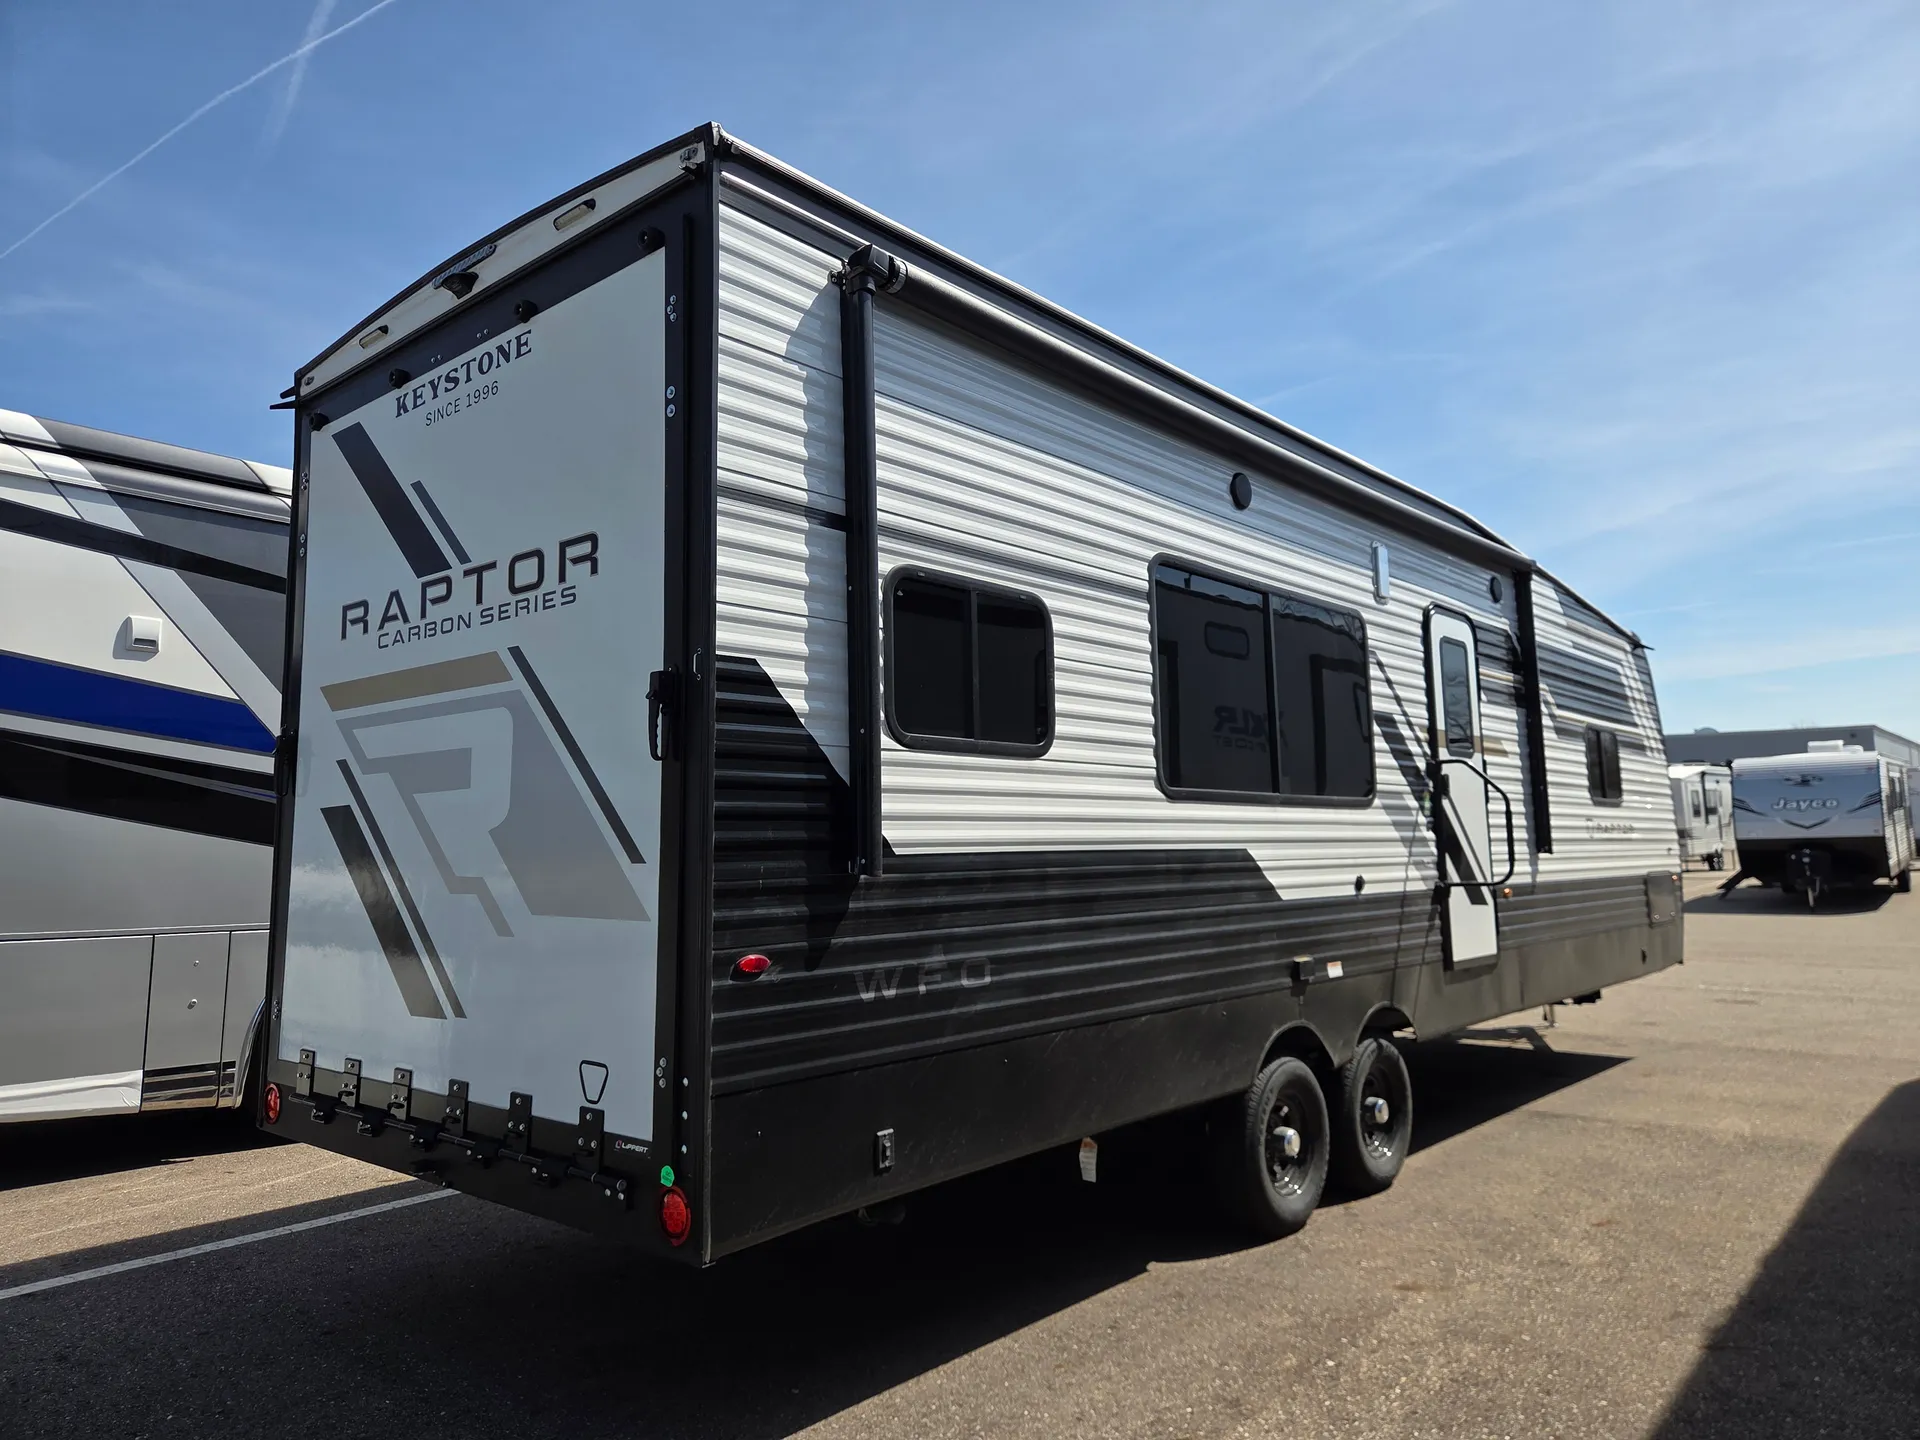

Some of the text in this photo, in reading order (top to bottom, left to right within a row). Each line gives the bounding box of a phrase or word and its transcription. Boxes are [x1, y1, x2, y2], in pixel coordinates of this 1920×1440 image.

[395, 329, 533, 418] KEYSTONE
[425, 380, 499, 427] SINCE 1996
[340, 531, 600, 641] RAPTOR
[377, 585, 577, 649] CARBON SERIES
[1771, 797, 1839, 812] Jayco
[854, 957, 992, 1002] WFO
